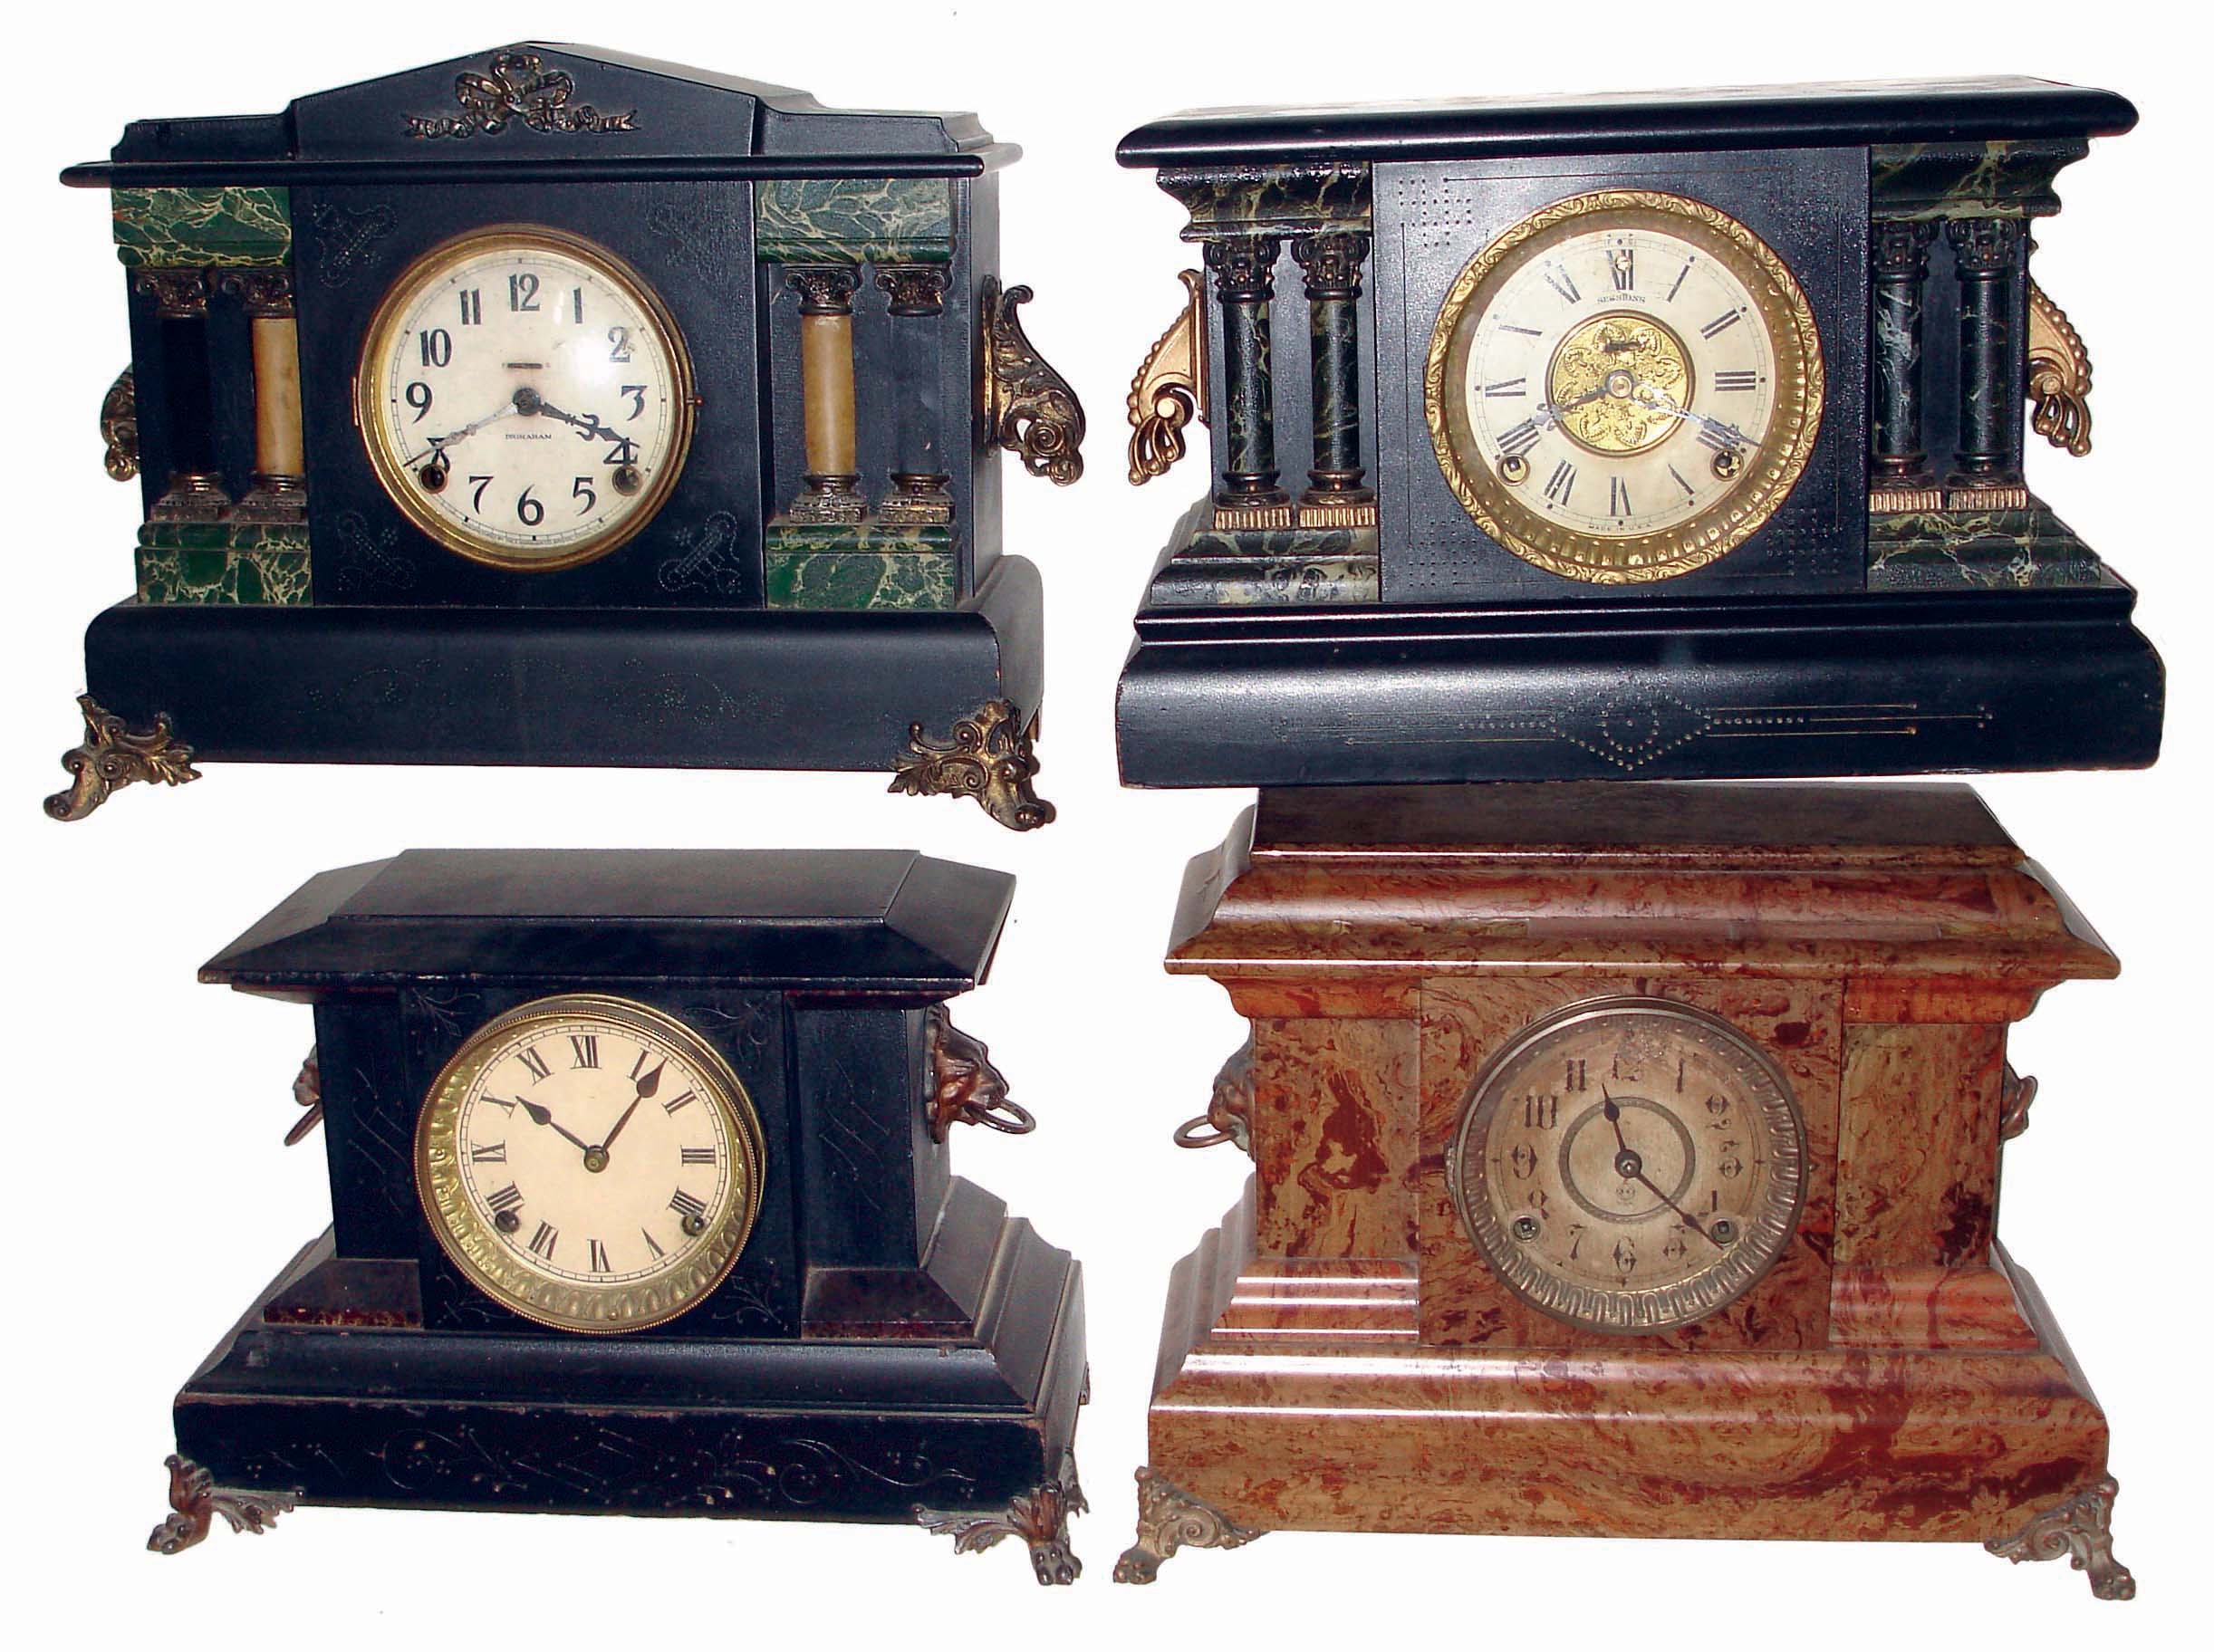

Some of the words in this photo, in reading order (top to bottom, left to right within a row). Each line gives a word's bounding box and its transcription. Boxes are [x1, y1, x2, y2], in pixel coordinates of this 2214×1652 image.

[459, 289, 482, 325] 11
[509, 274, 541, 312] 12
[572, 287, 583, 324] 1
[1699, 308, 1741, 341] II
[419, 329, 453, 368] 10
[607, 326, 633, 363] 2
[1714, 370, 1757, 392] III
[406, 381, 432, 424] 9
[621, 385, 648, 421] 3
[603, 437, 639, 466] 4
[468, 475, 494, 514] 7
[516, 485, 544, 526] 6
[572, 476, 597, 516] 5
[514, 1045, 554, 1086] XI
[566, 1034, 602, 1070] XII
[625, 1049, 651, 1083] I
[1565, 1059, 1587, 1092] 11
[1676, 1058, 1685, 1093] 1
[478, 1088, 516, 1119] X
[660, 1087, 699, 1118] II
[1525, 1094, 1558, 1130] 10
[470, 1138, 507, 1165] IX
[679, 1143, 717, 1167] III
[1510, 1144, 1538, 1179] 9
[666, 1186, 709, 1216] IIII
[525, 1220, 560, 1261] VII
[586, 1238, 613, 1273] VI
[640, 1226, 668, 1262] V
[1612, 1235, 1638, 1274] 6
